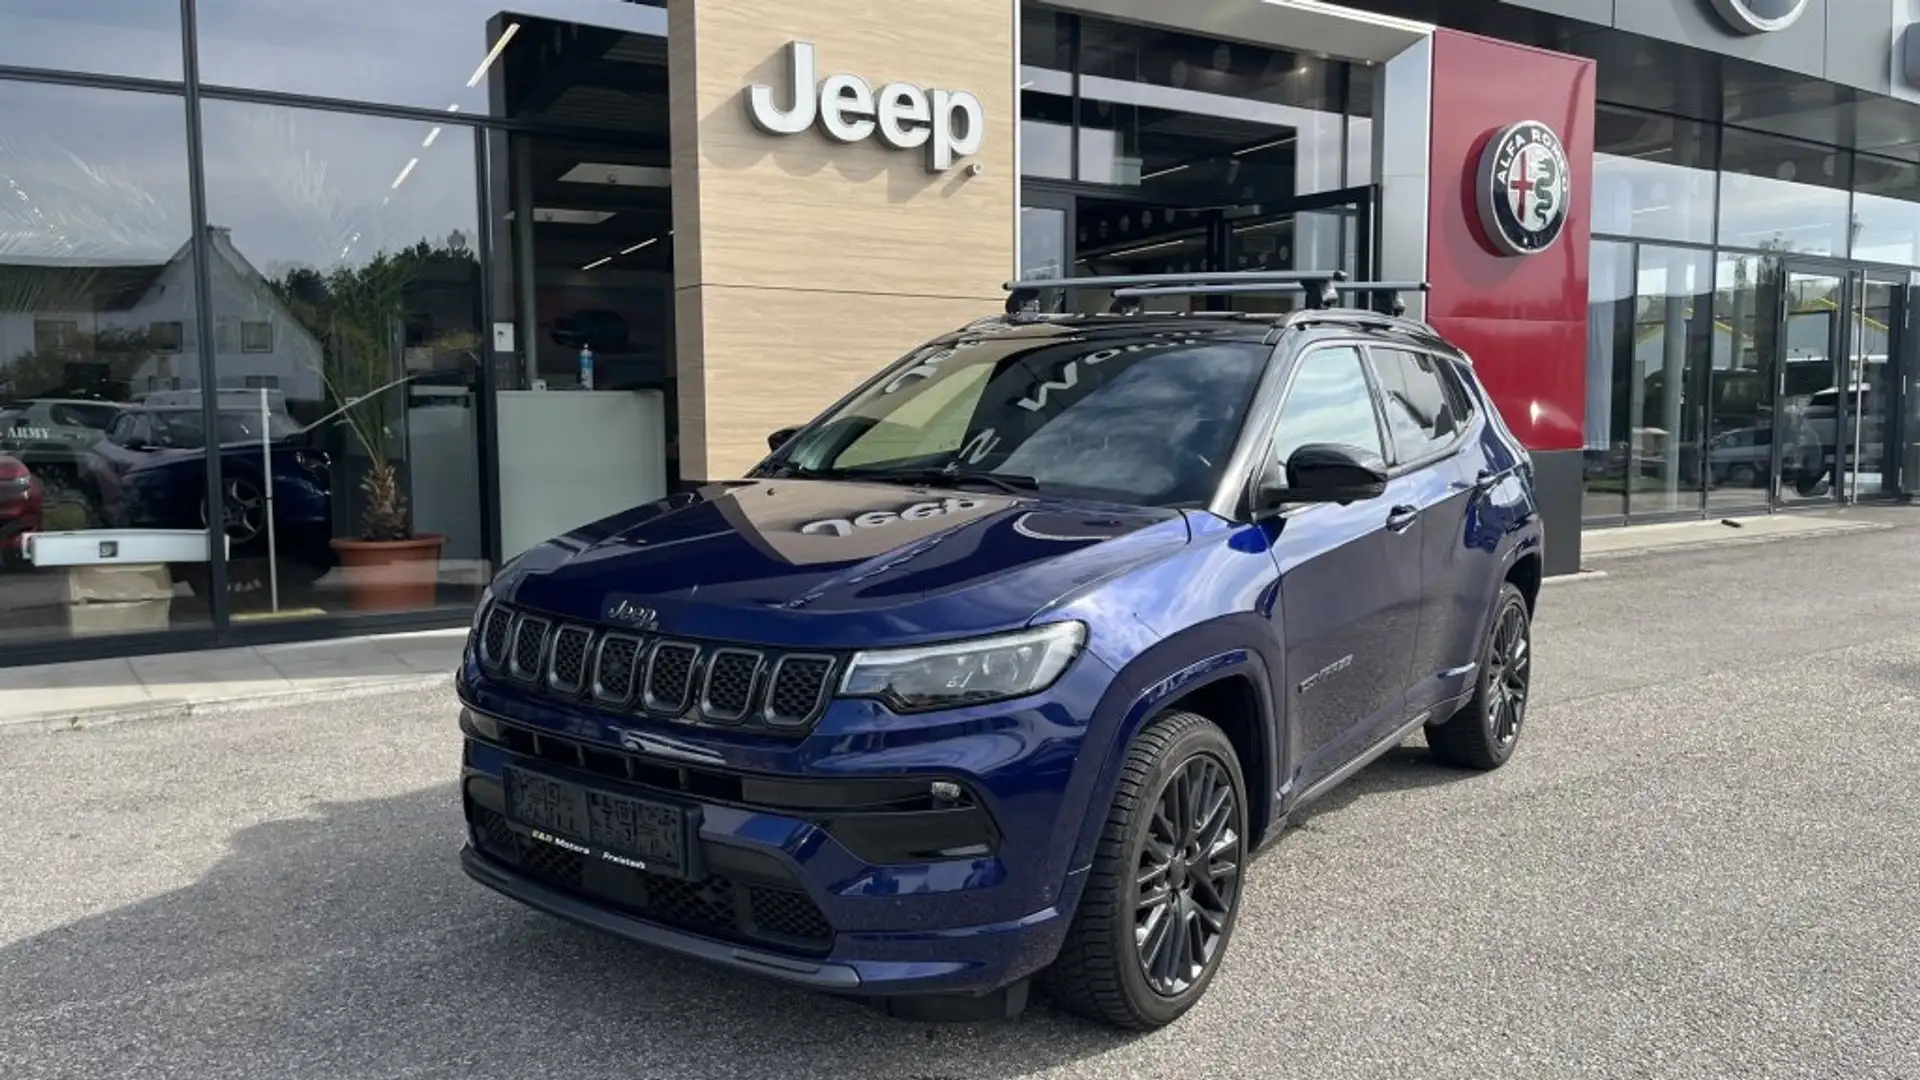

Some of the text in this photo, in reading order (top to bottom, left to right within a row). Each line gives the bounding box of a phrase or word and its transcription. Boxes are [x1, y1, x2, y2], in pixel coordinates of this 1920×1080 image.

[746, 40, 985, 172] Jeep
[1497, 128, 1567, 192] ALFA ROMO
[8, 427, 49, 440] ARMY
[608, 600, 656, 627] Jeep
